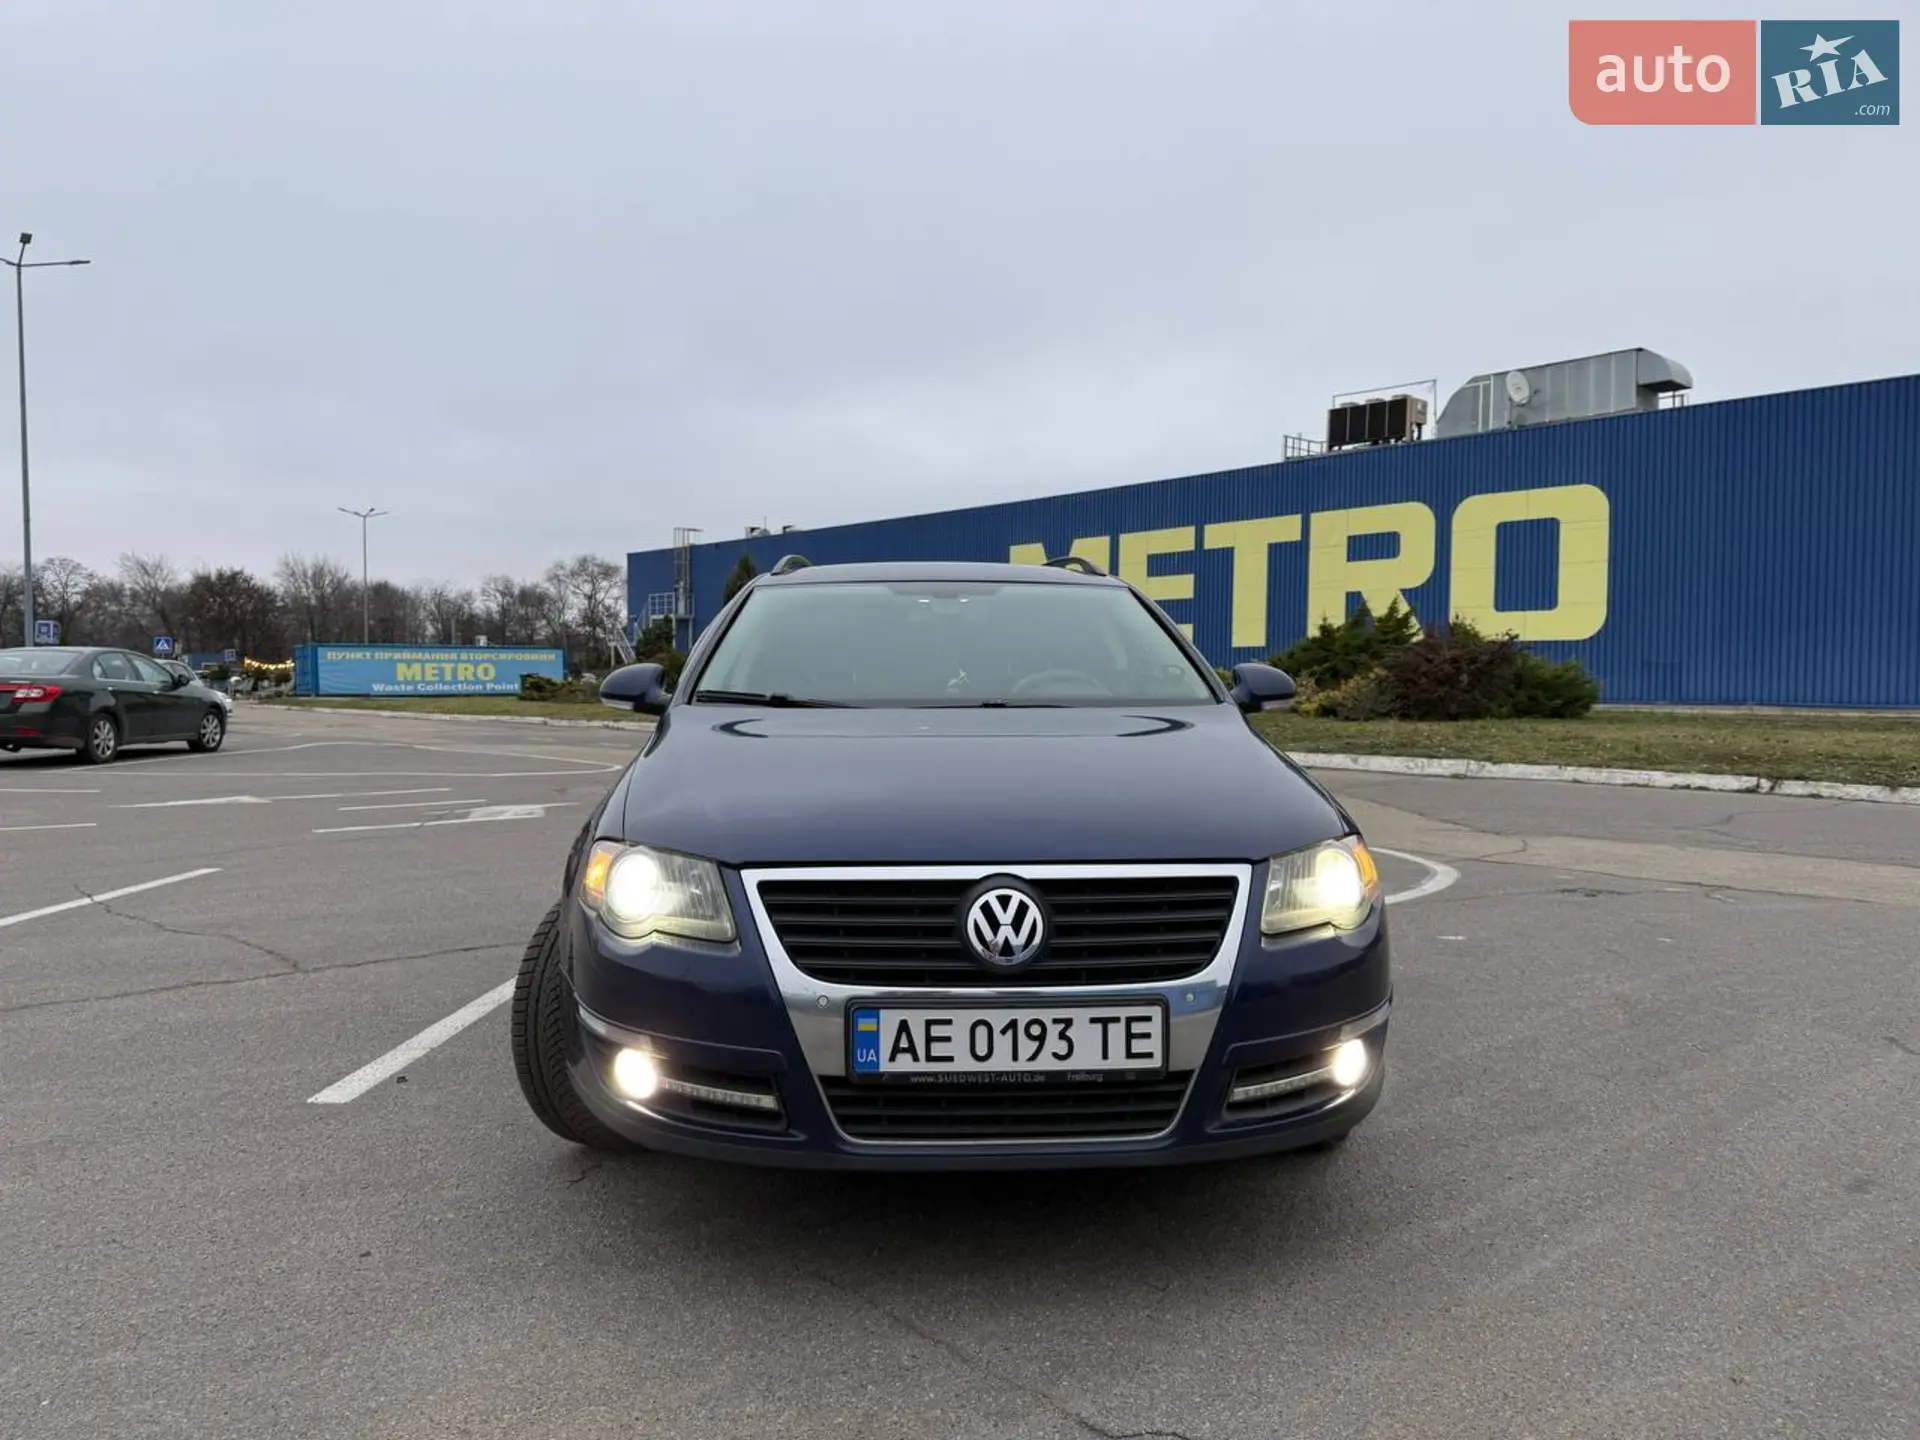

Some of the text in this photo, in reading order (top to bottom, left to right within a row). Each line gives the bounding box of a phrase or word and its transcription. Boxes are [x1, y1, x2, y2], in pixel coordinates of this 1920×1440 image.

[326, 651, 371, 661] ПУНКТ
[396, 662, 496, 681] METRO
[372, 682, 518, 692] Waste Collection Point
[888, 1015, 1154, 1063] AE 0193 TE
[857, 1049, 877, 1063] UA
